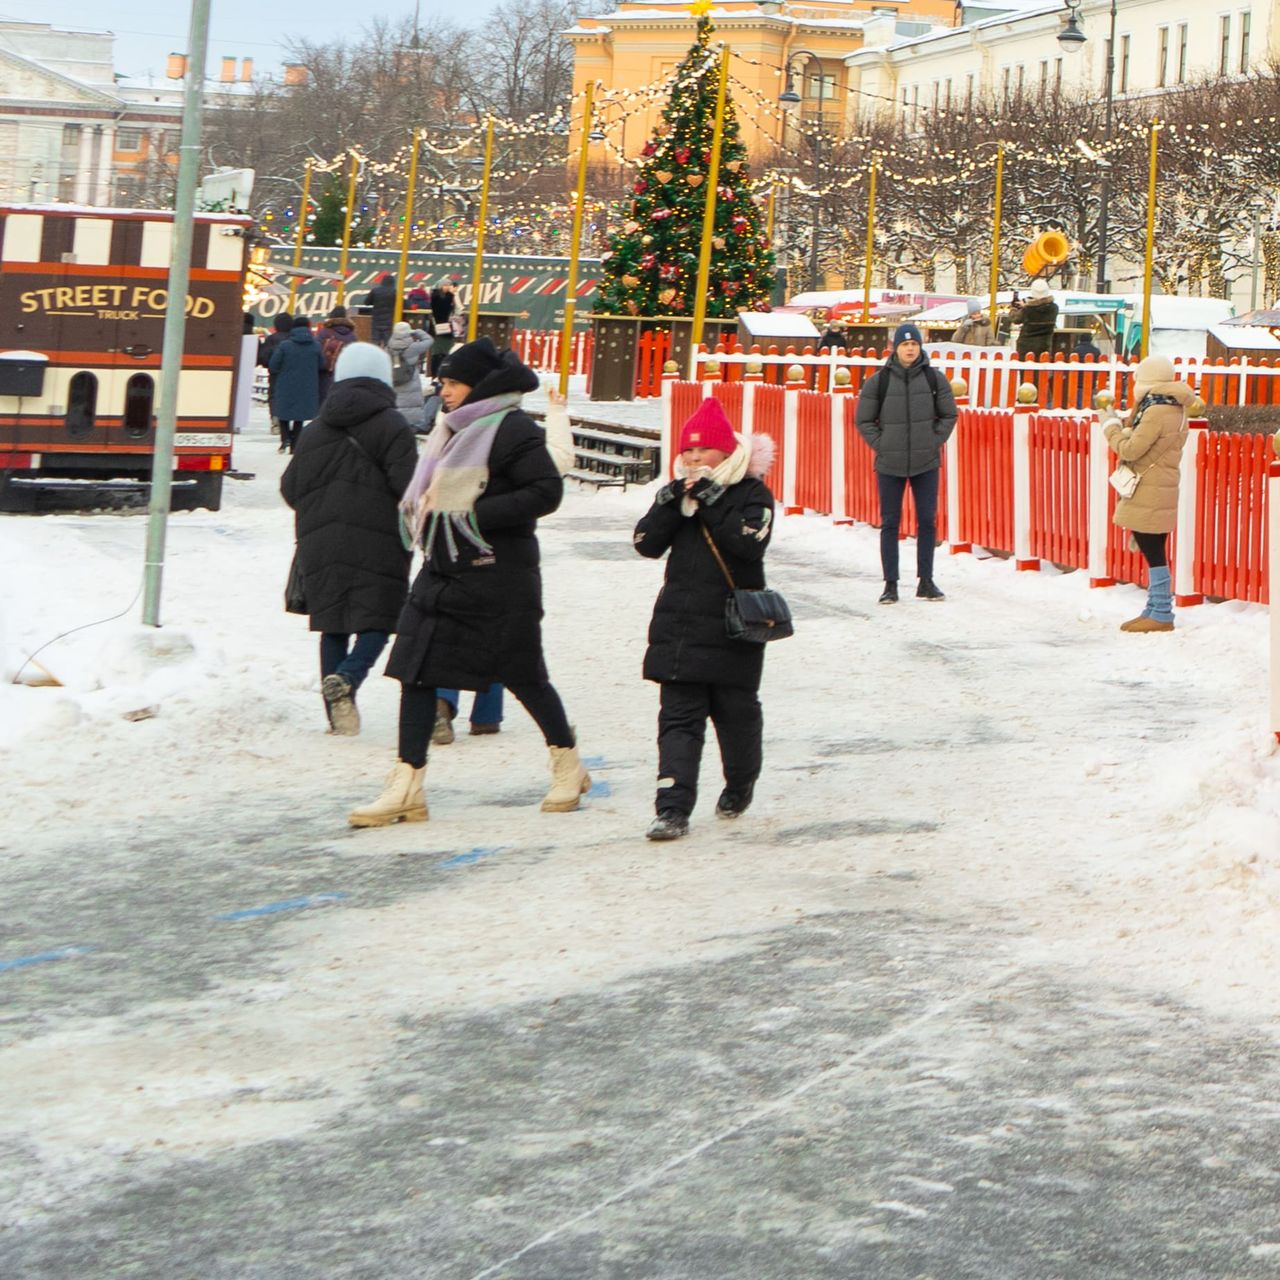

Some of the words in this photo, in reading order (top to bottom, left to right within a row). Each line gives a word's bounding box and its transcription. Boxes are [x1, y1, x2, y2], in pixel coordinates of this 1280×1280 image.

[20, 285, 127, 313] STREET
[131, 286, 216, 319] FOD
[97, 309, 139, 320] TRUCK
